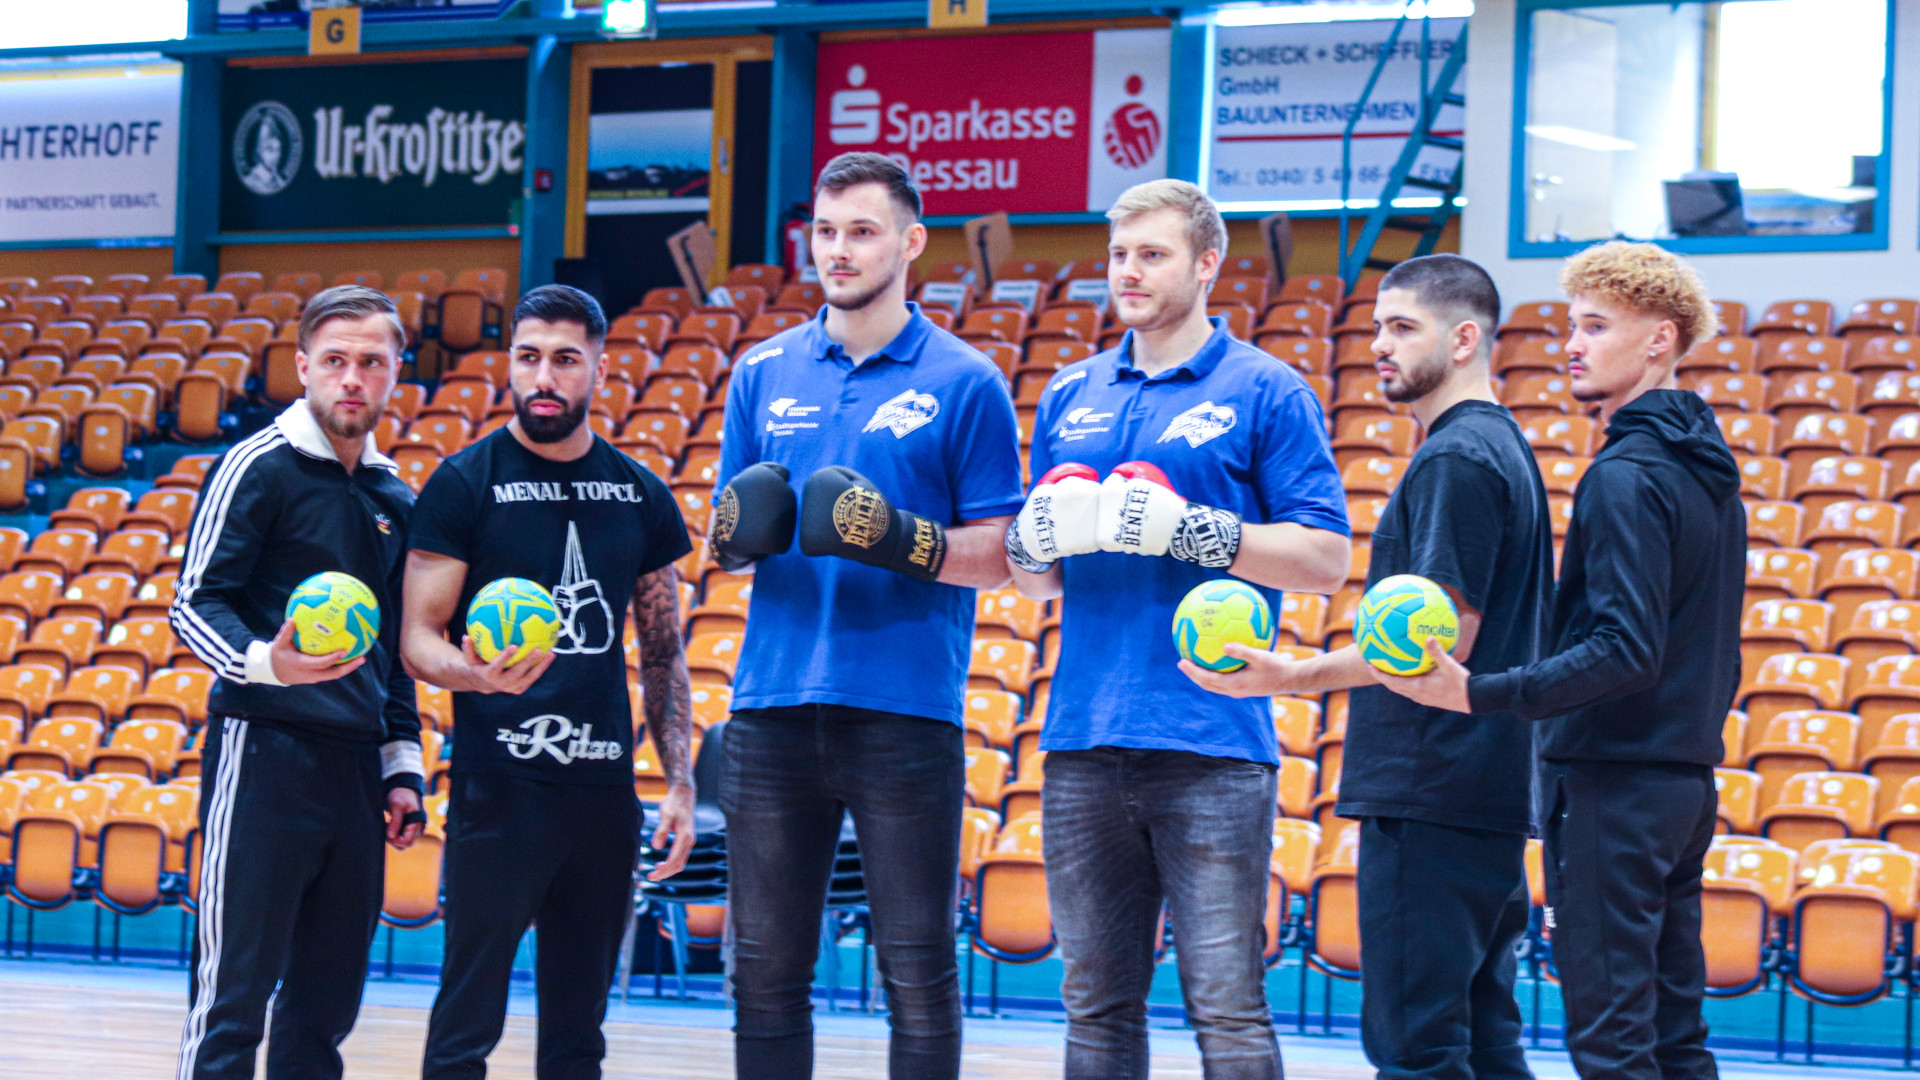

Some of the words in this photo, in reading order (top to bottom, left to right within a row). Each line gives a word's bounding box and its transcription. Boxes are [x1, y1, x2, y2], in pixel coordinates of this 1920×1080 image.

[325, 18, 345, 43] G
[1219, 45, 1309, 67] SCHIECK
[1219, 76, 1280, 95] GmbH
[0, 121, 162, 160] HTERHOFF
[886, 99, 1076, 152] Sparkasse
[492, 481, 570, 504] MENAL
[842, 485, 880, 549] BENLEE
[1124, 487, 1151, 547] BENLEE
[1033, 497, 1055, 557] BENLEE
[1184, 504, 1231, 567] BENLEE
[506, 714, 623, 765] Ritze
